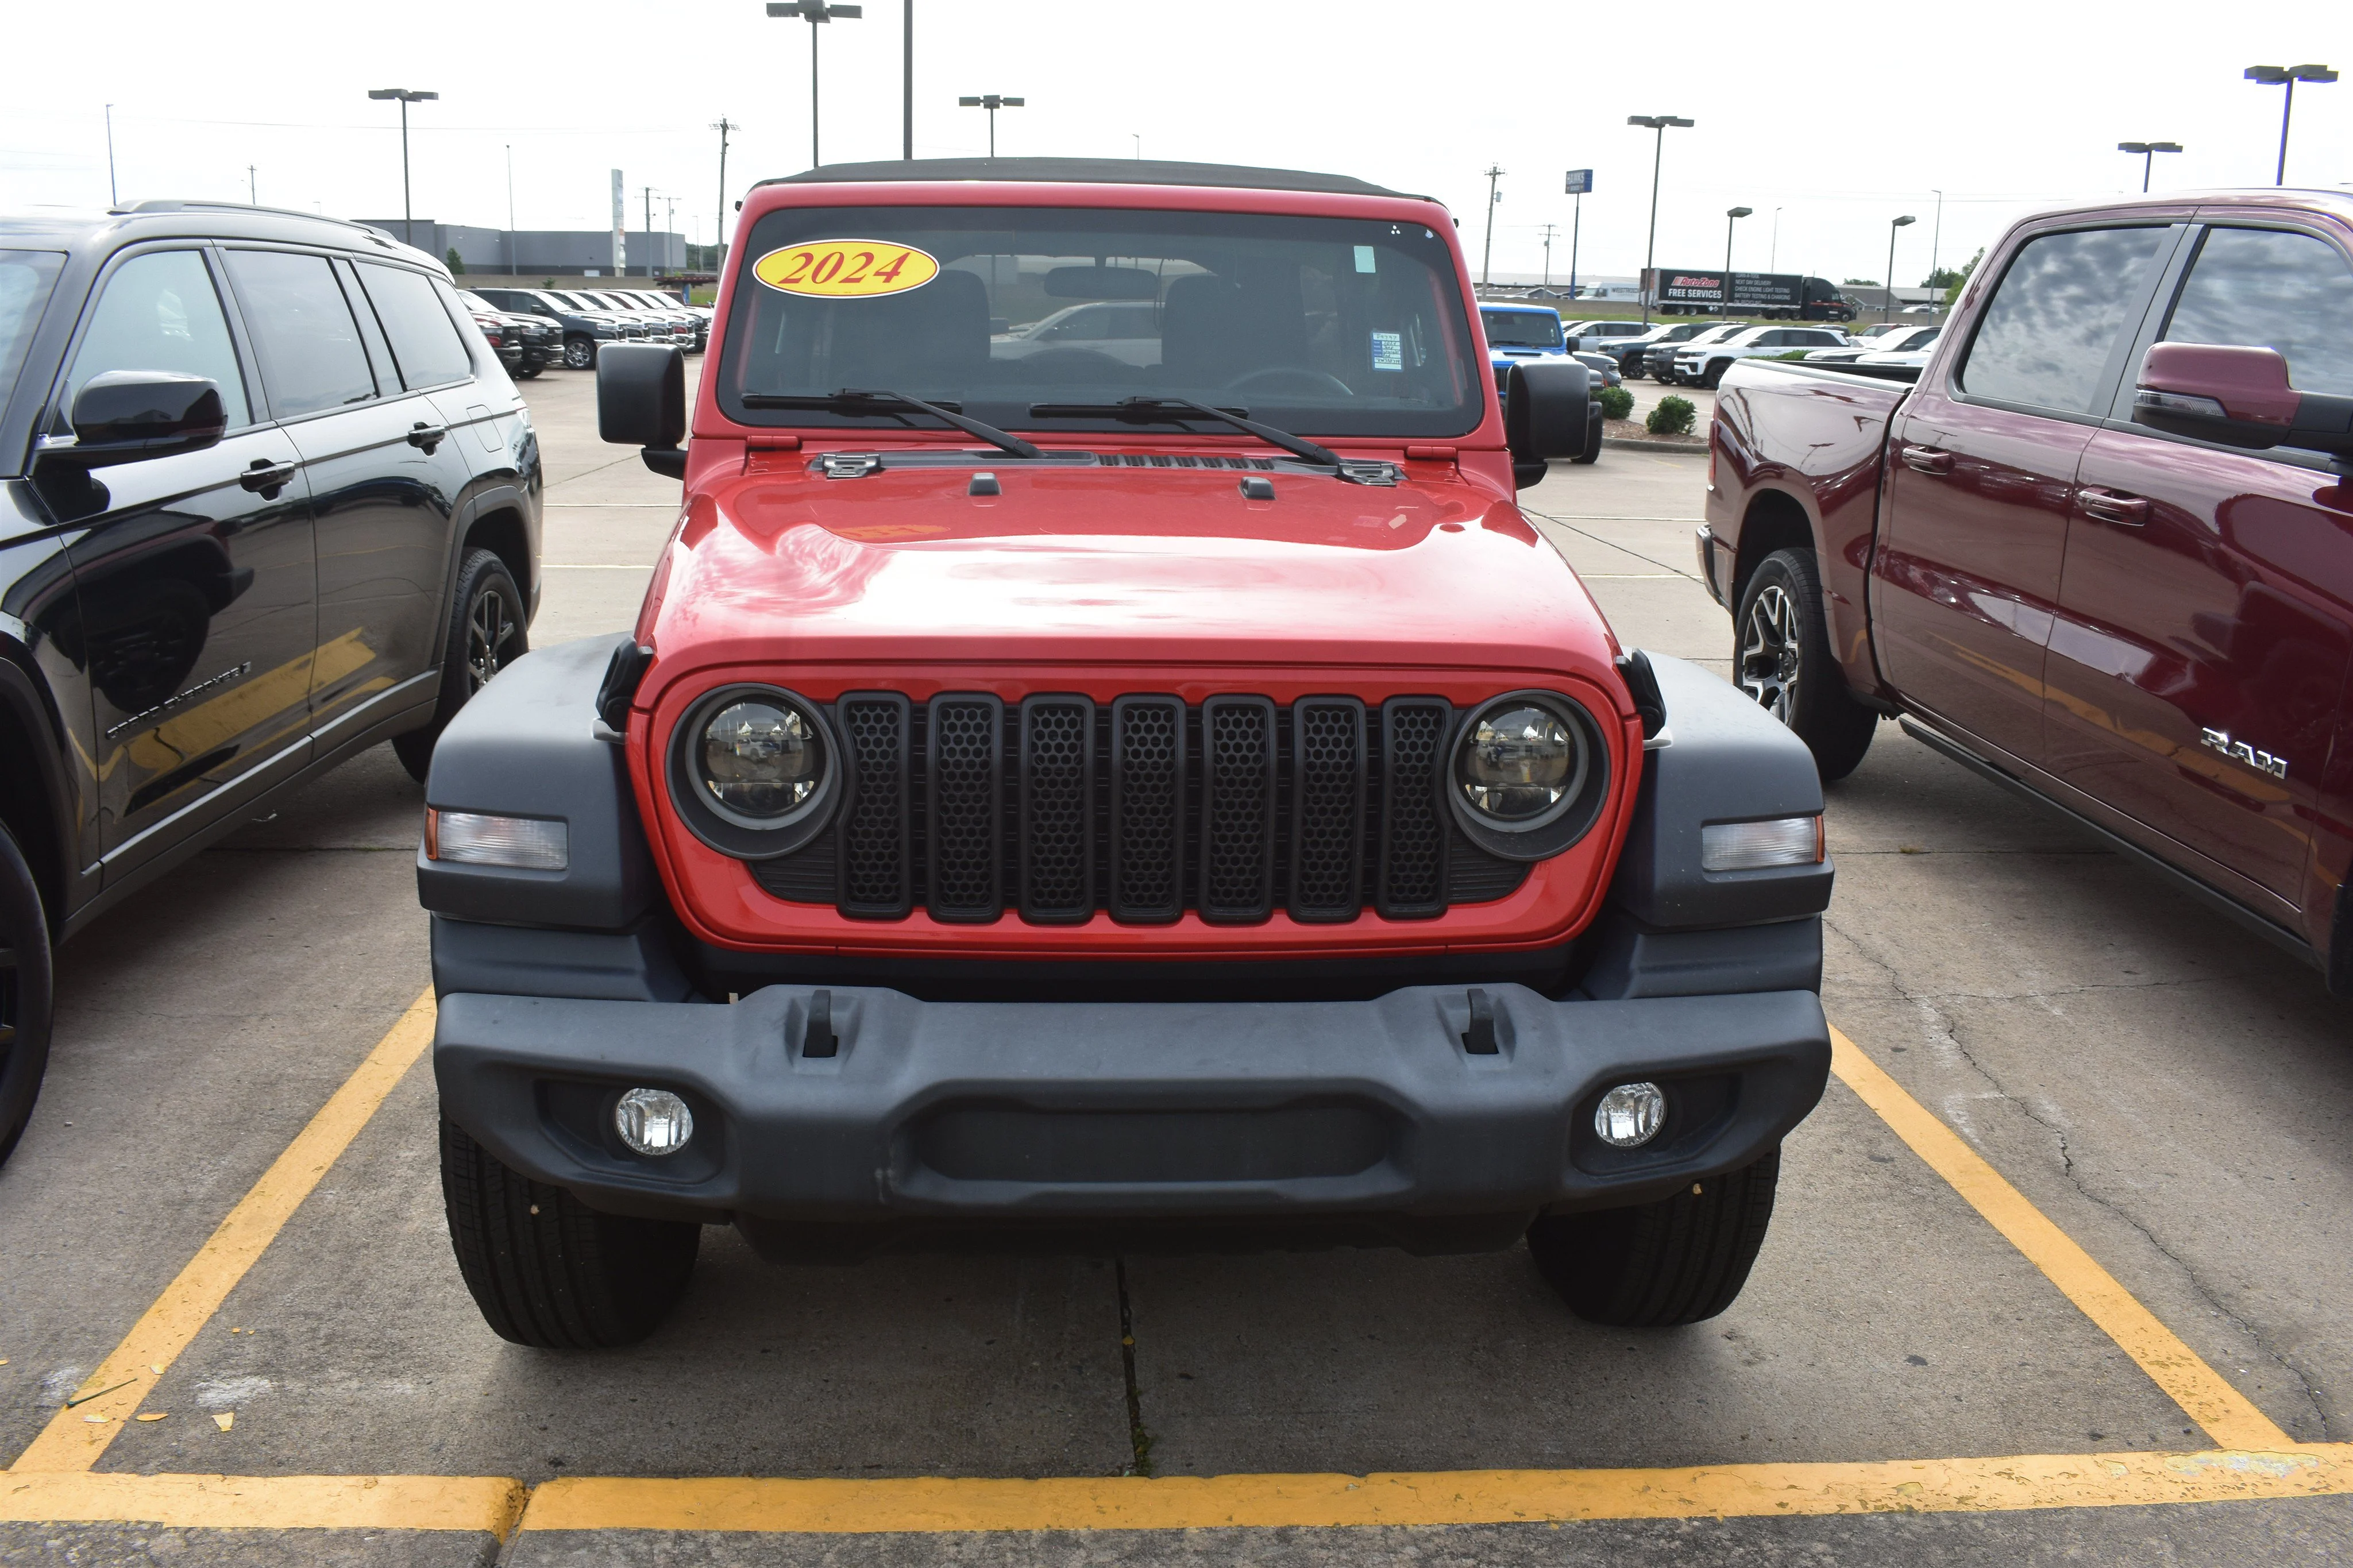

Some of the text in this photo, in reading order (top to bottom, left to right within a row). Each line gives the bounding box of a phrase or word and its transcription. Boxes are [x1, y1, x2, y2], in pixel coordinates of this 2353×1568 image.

[777, 252, 911, 284] 2024
[1668, 288, 1722, 298] FREE SERVICES
[1680, 276, 1720, 288] AutoZone
[2200, 727, 2288, 780] RAM
